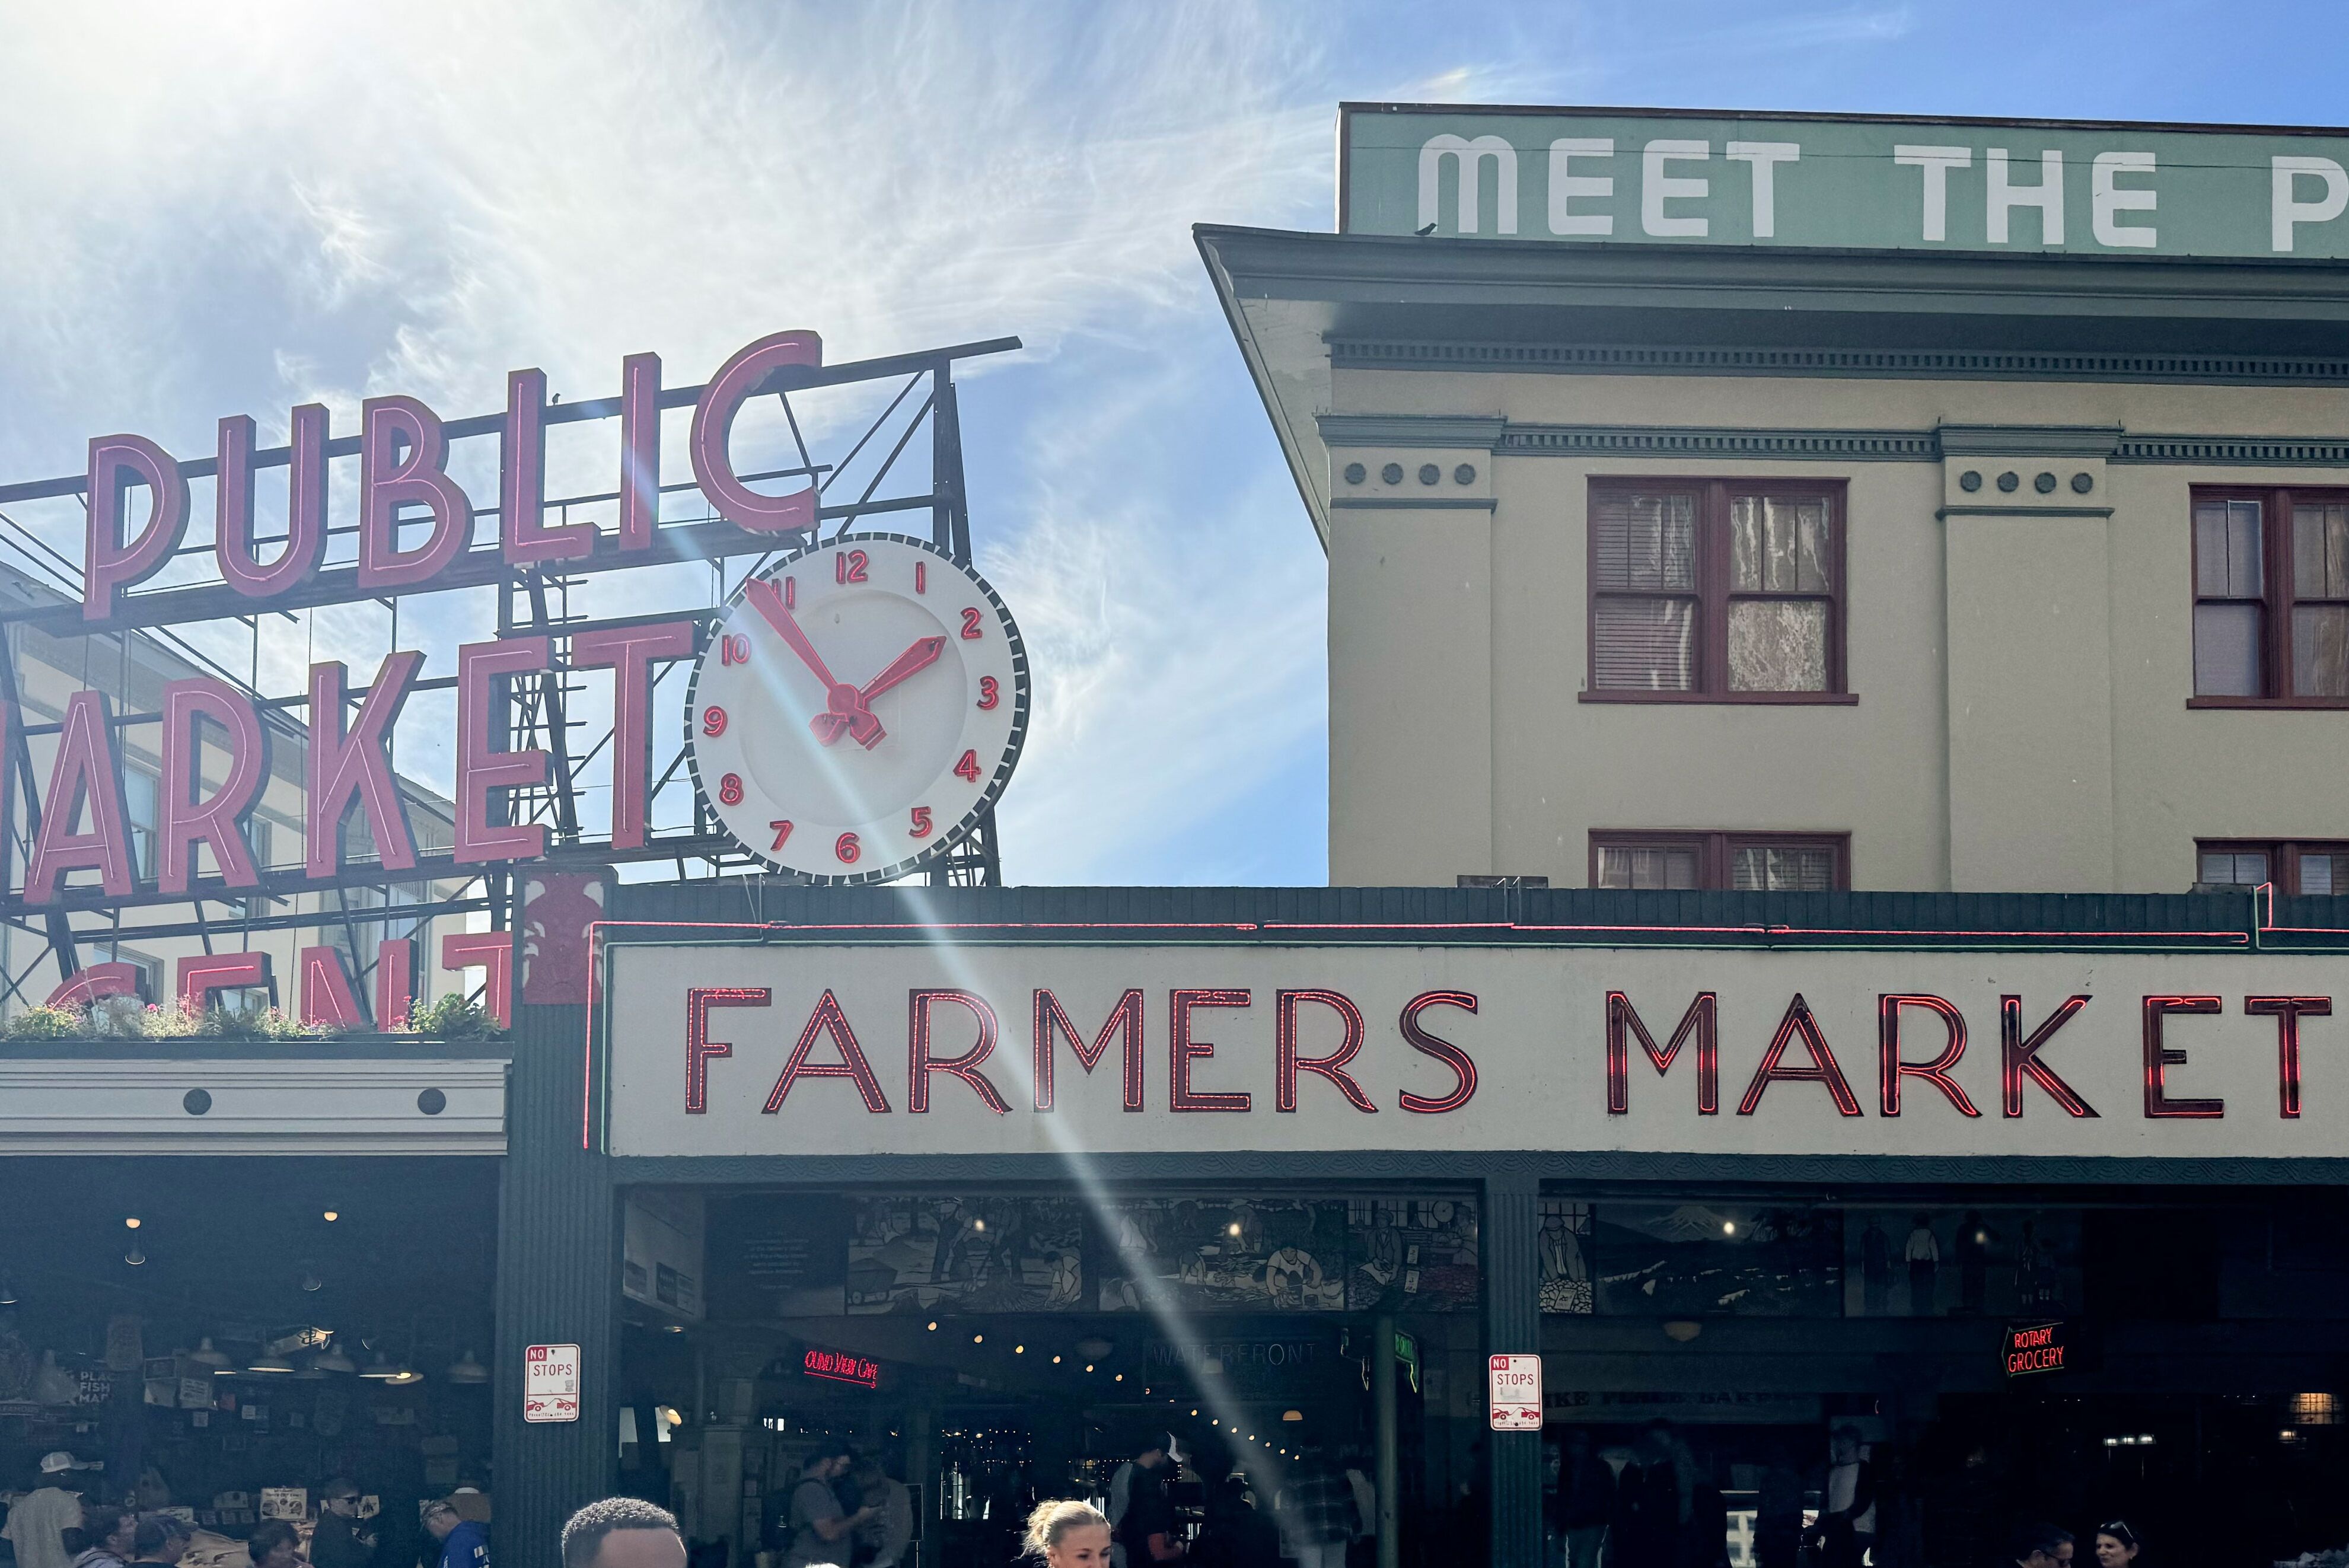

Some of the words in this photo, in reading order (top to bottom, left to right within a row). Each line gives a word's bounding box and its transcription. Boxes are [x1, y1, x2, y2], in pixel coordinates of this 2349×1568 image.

[1419, 134, 1800, 237] MEET
[1894, 145, 2157, 248] THE
[84, 330, 823, 620] PUBLIC
[836, 549, 868, 584] 12
[916, 561, 926, 593] 1
[960, 607, 983, 640] 2
[721, 633, 752, 666] 10
[977, 675, 1000, 710] 3
[703, 706, 728, 737] 9
[0, 620, 694, 903] ARKET
[953, 749, 982, 783] 4
[719, 773, 745, 806] 8
[769, 820, 794, 851] 7
[909, 806, 933, 838] 5
[835, 832, 860, 863] 6
[685, 989, 1478, 1114] FARMERS
[1606, 991, 2332, 1119] MARKET
[2014, 1327, 2052, 1348] ROTARY
[530, 1349, 544, 1360] NO
[533, 1363, 572, 1376] STOPS
[1153, 1343, 1317, 1365] WATERFRONT
[1493, 1358, 1506, 1369] NO
[2008, 1346, 2064, 1372] GROCERY
[79, 1382, 111, 1392] FISH
[1497, 1373, 1534, 1385] STOPS
